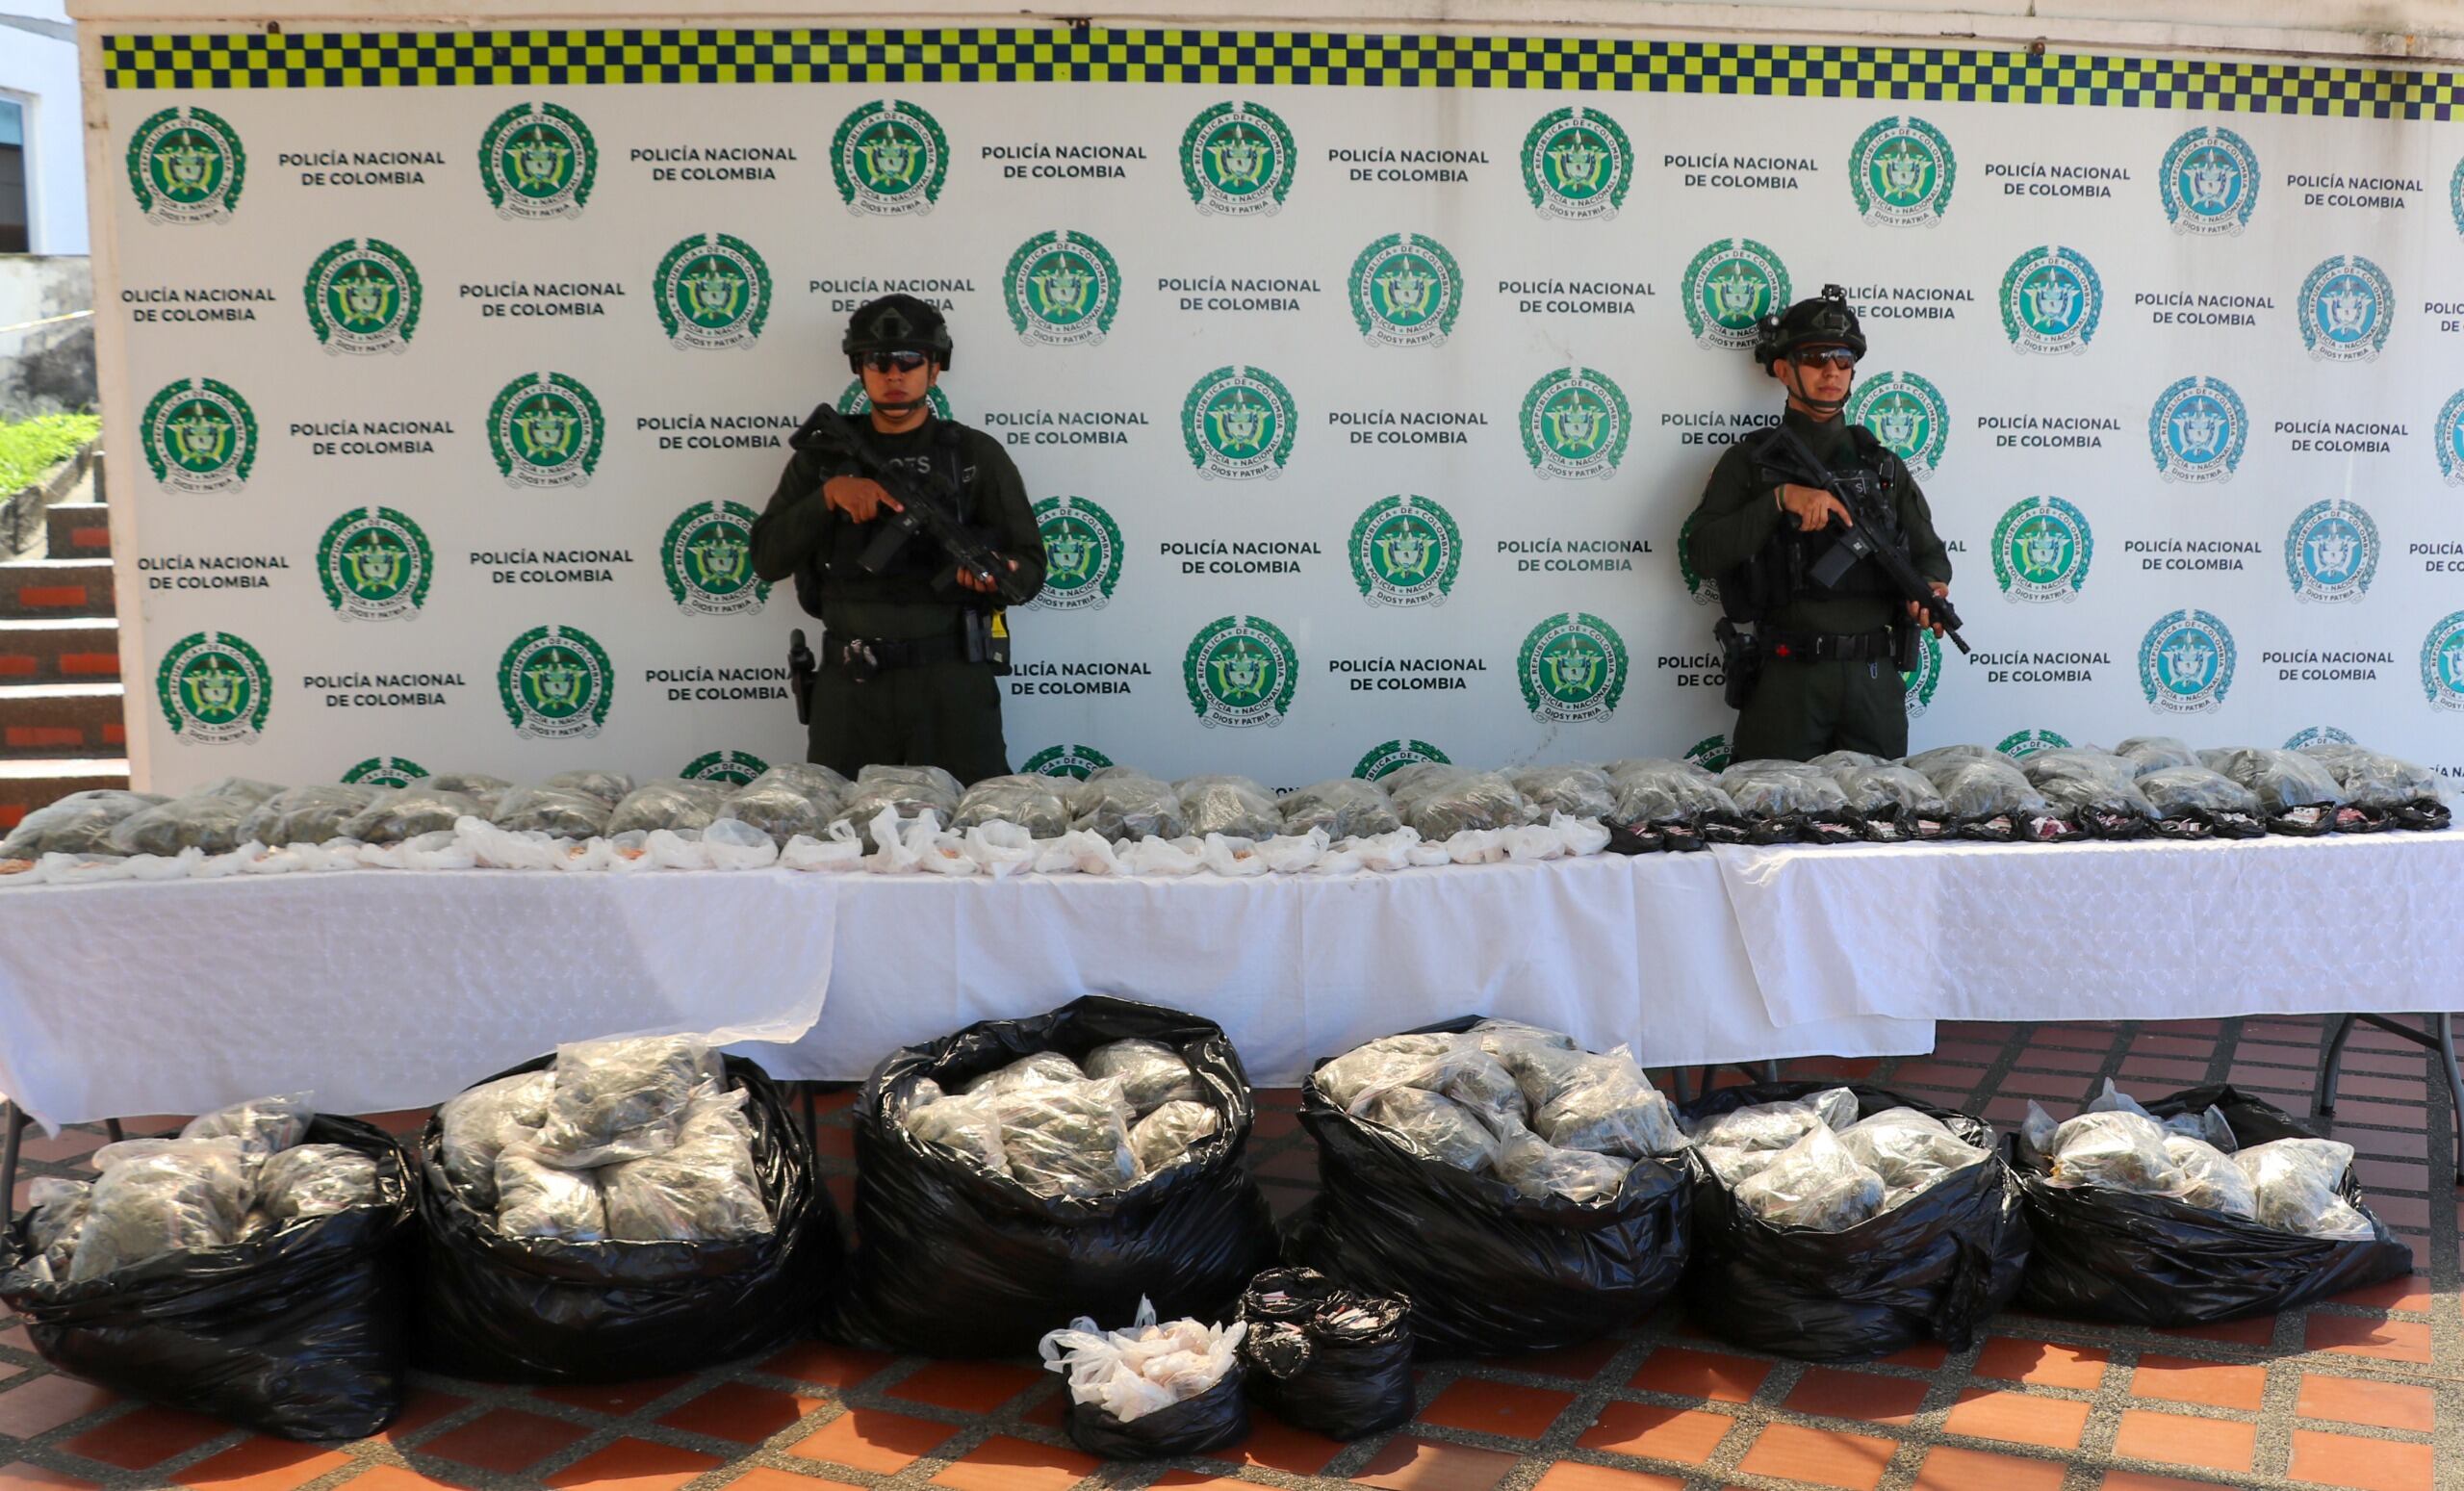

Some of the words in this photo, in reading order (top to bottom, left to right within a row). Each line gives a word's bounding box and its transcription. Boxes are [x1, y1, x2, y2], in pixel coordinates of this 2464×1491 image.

[279, 151, 349, 167] POLICÍA
[353, 151, 446, 166] NACIONAL
[630, 145, 701, 162] POLICÍA
[705, 147, 797, 162] NACIONAL
[982, 143, 1051, 160] POLICÍA
[1055, 145, 1147, 160] NACIONAL
[1328, 147, 1397, 163] POLICÍA
[1400, 150, 1489, 164] NACIONAL
[1664, 153, 1730, 168] POLICÍA
[1733, 157, 1818, 171] NACIONAL
[301, 172, 325, 186] DE
[329, 171, 424, 186] COLOMBIA
[653, 167, 677, 181] DE
[680, 167, 776, 181] COLOMBIA
[1004, 166, 1027, 178] DE
[1031, 165, 1126, 178] COLOMBIA
[1349, 168, 1373, 181] DE
[1376, 168, 1469, 182] COLOMBIA
[1985, 162, 2046, 178] POLICÍA
[2050, 166, 2130, 180] NACIONAL
[1684, 174, 1707, 187] DE
[1710, 175, 1798, 189] COLOMBIA
[2287, 172, 2345, 189] POLICÍA
[2348, 177, 2424, 192] NACIONAL
[2004, 183, 2025, 195] DE
[2029, 184, 2112, 197] COLOMBIA
[2304, 193, 2324, 206] DE
[2327, 194, 2405, 209] COLOMBIA
[460, 282, 529, 298] POLICÍA
[533, 283, 626, 296] NACIONAL
[809, 276, 880, 294] POLICÍA
[884, 279, 975, 293] NACIONAL
[1158, 276, 1226, 292] POLICÍA
[1231, 279, 1321, 293] NACIONAL
[1499, 279, 1565, 295] POLICÍA
[1569, 282, 1656, 296] NACIONAL
[185, 289, 276, 302] NACIONAL
[1892, 288, 1975, 301] NACIONAL
[2135, 291, 2194, 306] POLICÍA
[2197, 295, 2274, 309] NACIONAL
[482, 303, 506, 317] DE
[510, 302, 604, 317] COLOMBIA
[832, 299, 856, 313] DE
[1180, 297, 1203, 311] DE
[1207, 298, 1300, 311] COLOMBIA
[1520, 300, 1542, 313] DE
[1546, 300, 1635, 314] COLOMBIA
[133, 309, 157, 322] DE
[161, 308, 256, 322] COLOMBIA
[1870, 306, 1956, 320] COLOMBIA
[2153, 312, 2173, 323] DE
[2176, 312, 2256, 326] COLOMBIA
[2441, 321, 2460, 332] DE
[636, 413, 706, 430] POLICÍA
[710, 415, 803, 429] NACIONAL
[985, 409, 1054, 425] POLICÍA
[1058, 412, 1149, 425] NACIONAL
[1329, 410, 1397, 425] POLICÍA
[1400, 412, 1488, 425] NACIONAL
[1661, 410, 1726, 426] POLICÍA
[1978, 415, 2039, 429] POLICÍA
[2042, 418, 2120, 430] NACIONAL
[290, 421, 359, 436] POLICÍA
[363, 421, 454, 435] NACIONAL
[2274, 420, 2331, 434] POLICÍA
[2335, 423, 2408, 436] NACIONAL
[659, 436, 683, 450] DE
[687, 435, 782, 449] COLOMBIA
[1006, 431, 1031, 445] DE
[1034, 431, 1129, 445] COLOMBIA
[1350, 431, 1373, 444] DE
[1376, 431, 1468, 444] COLOMBIA
[1681, 432, 1705, 445] DE
[1996, 435, 2017, 447] DE
[2020, 435, 2101, 448] COLOMBIA
[313, 442, 336, 455] DE
[341, 441, 434, 455] COLOMBIA
[2292, 439, 2311, 451] DE
[2314, 440, 2390, 452] COLOMBIA
[1422, 512, 1449, 556] COLOMBIA
[1160, 540, 1229, 555] POLICÍA
[1232, 541, 1322, 555] NACIONAL
[1498, 537, 1563, 553] POLICÍA
[1567, 540, 1653, 553] NACIONAL
[2124, 538, 2183, 553] POLICÍA
[2186, 541, 2262, 553] NACIONAL
[2409, 540, 2464, 555] POLICÍA
[199, 556, 290, 570] NACIONAL
[470, 549, 539, 565] POLICÍA
[543, 550, 634, 563] NACIONAL
[2142, 558, 2162, 570] DE
[2166, 558, 2244, 571] COLOMBIA
[1182, 561, 1205, 575] DE
[1209, 560, 1301, 574] COLOMBIA
[1518, 559, 1540, 572] DE
[1544, 559, 1632, 572] COLOMBIA
[2426, 560, 2445, 572] DE
[149, 577, 172, 590] DE
[176, 576, 270, 589] COLOMBIA
[492, 570, 516, 584] DE
[520, 569, 613, 583] COLOMBIA
[1406, 568, 1444, 593] NACIONAL
[1406, 592, 1434, 604] PATRIA
[1257, 633, 1285, 677] COLOMBIA
[1657, 654, 1722, 669] POLICÍA
[1969, 651, 2030, 665] POLICÍA
[2033, 653, 2111, 664] NACIONAL
[2262, 650, 2318, 663] POLICÍA
[2322, 652, 2394, 663] NACIONAL
[1062, 662, 1152, 676] NACIONAL
[1329, 656, 1397, 673] POLICÍA
[1399, 658, 1487, 672] NACIONAL
[304, 673, 372, 688] POLICÍA
[375, 674, 466, 687] NACIONAL
[645, 666, 715, 682] POLICÍA
[1678, 674, 1700, 686] DE
[1988, 670, 2009, 682] DE
[2012, 670, 2092, 682] COLOMBIA
[2279, 669, 2298, 681] DE
[2301, 669, 2376, 681] COLOMBIA
[1011, 682, 1036, 696] DE
[1039, 681, 1132, 695] COLOMBIA
[1349, 678, 1373, 691] DE
[1376, 677, 1467, 691] COLOMBIA
[326, 694, 349, 707] DE
[353, 692, 446, 707] COLOMBIA
[667, 687, 692, 701] DE
[695, 686, 789, 701] COLOMBIA
[1242, 688, 1280, 714] NACIONAL
[1574, 683, 1610, 708] NACIONAL
[1242, 712, 1270, 725] PATRIA
